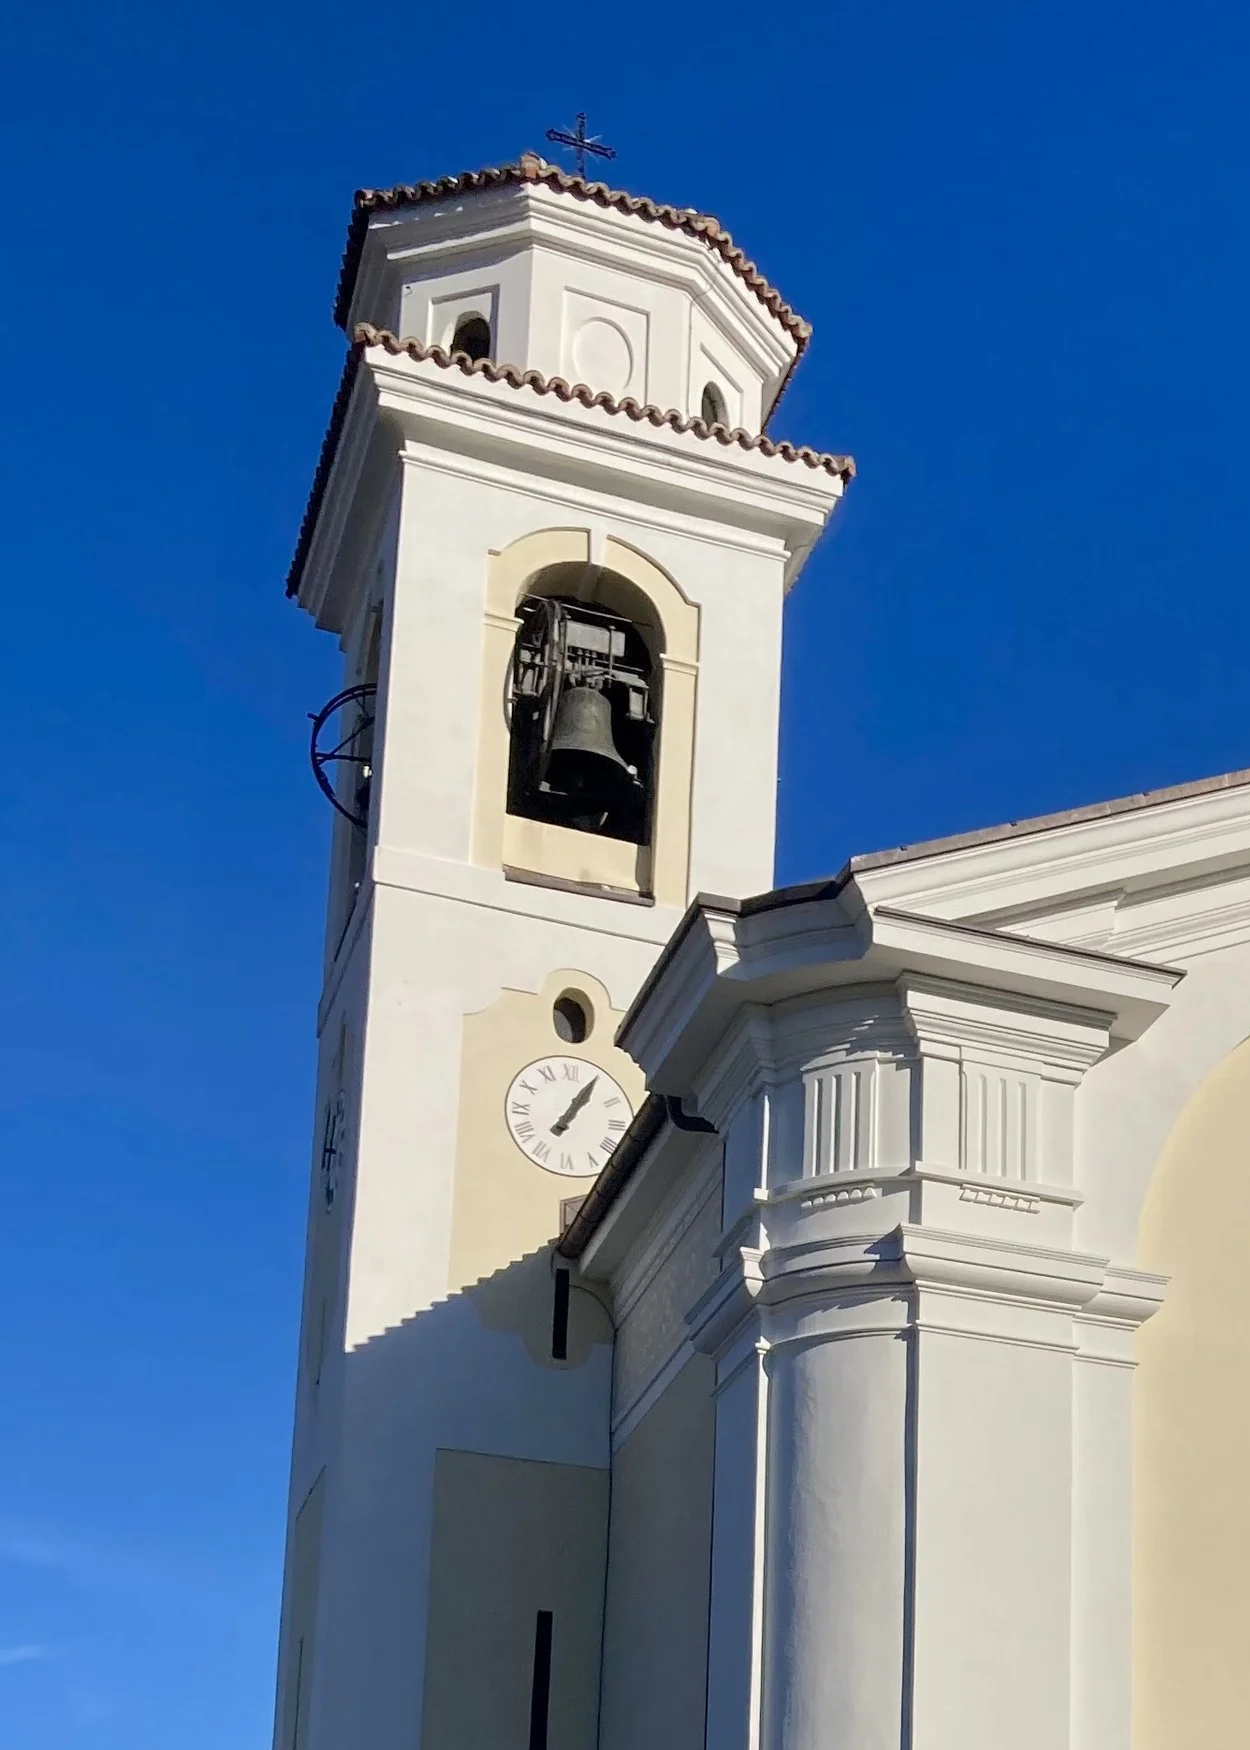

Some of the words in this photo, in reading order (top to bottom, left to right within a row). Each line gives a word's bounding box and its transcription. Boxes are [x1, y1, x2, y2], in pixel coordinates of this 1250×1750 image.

[537, 1065, 557, 1084] XI
[562, 1063, 580, 1083] XII
[518, 1079, 538, 1096] X
[511, 1101, 531, 1116] IX
[607, 1119, 627, 1132] III
[531, 1140, 552, 1163] VII
[560, 1151, 574, 1171] VI
